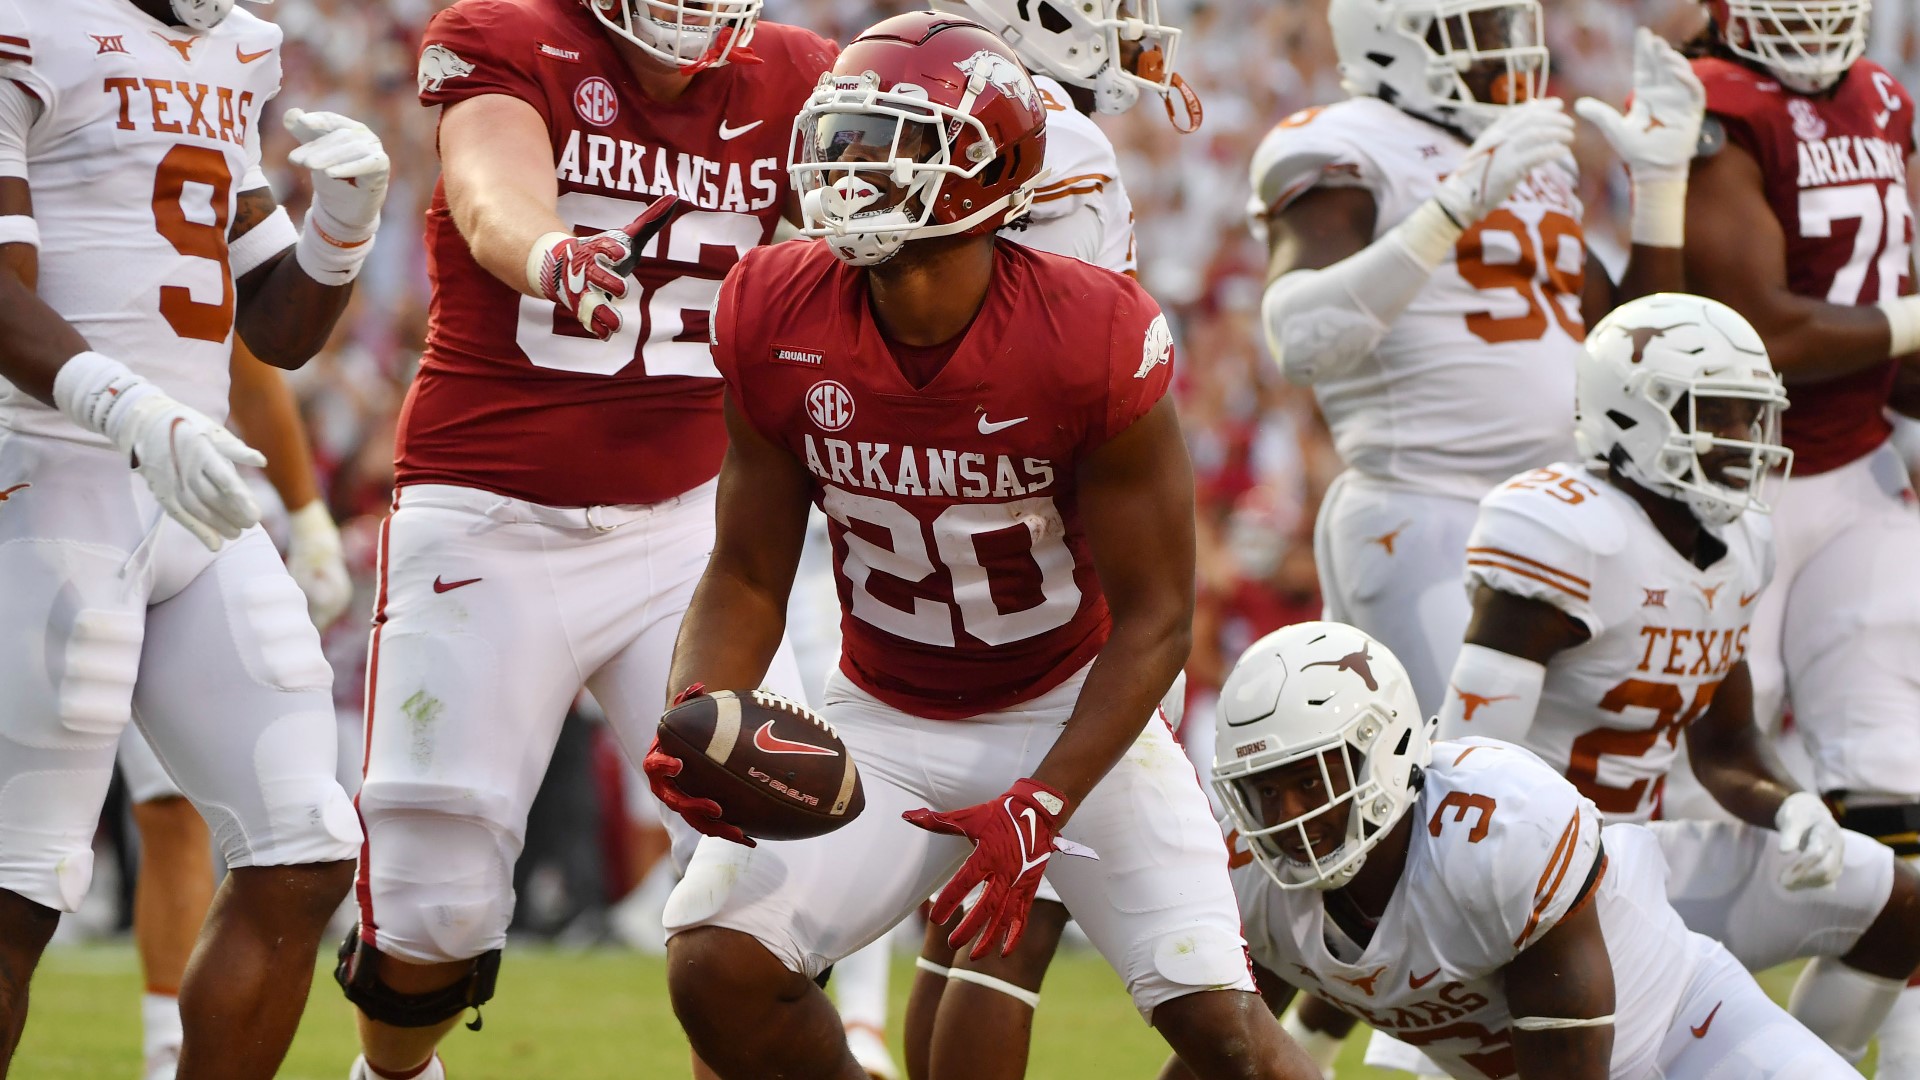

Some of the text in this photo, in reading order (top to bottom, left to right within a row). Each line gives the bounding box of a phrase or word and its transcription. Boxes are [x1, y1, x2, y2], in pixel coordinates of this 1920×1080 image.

[541, 44, 580, 60] EQUALITY
[104, 77, 253, 146] TEXAS
[580, 81, 615, 122] SEC
[556, 130, 777, 213] ARKANSAS
[152, 143, 234, 344] 9
[778, 350, 822, 365] EQUALITY
[810, 385, 850, 427] SEC
[804, 434, 1054, 498] ARKANSAS
[1506, 468, 1599, 505] 25
[823, 484, 1083, 647] 20
[1636, 625, 1749, 676] TEXAS
[1235, 739, 1267, 758] HORNS
[1427, 790, 1498, 844] 3
